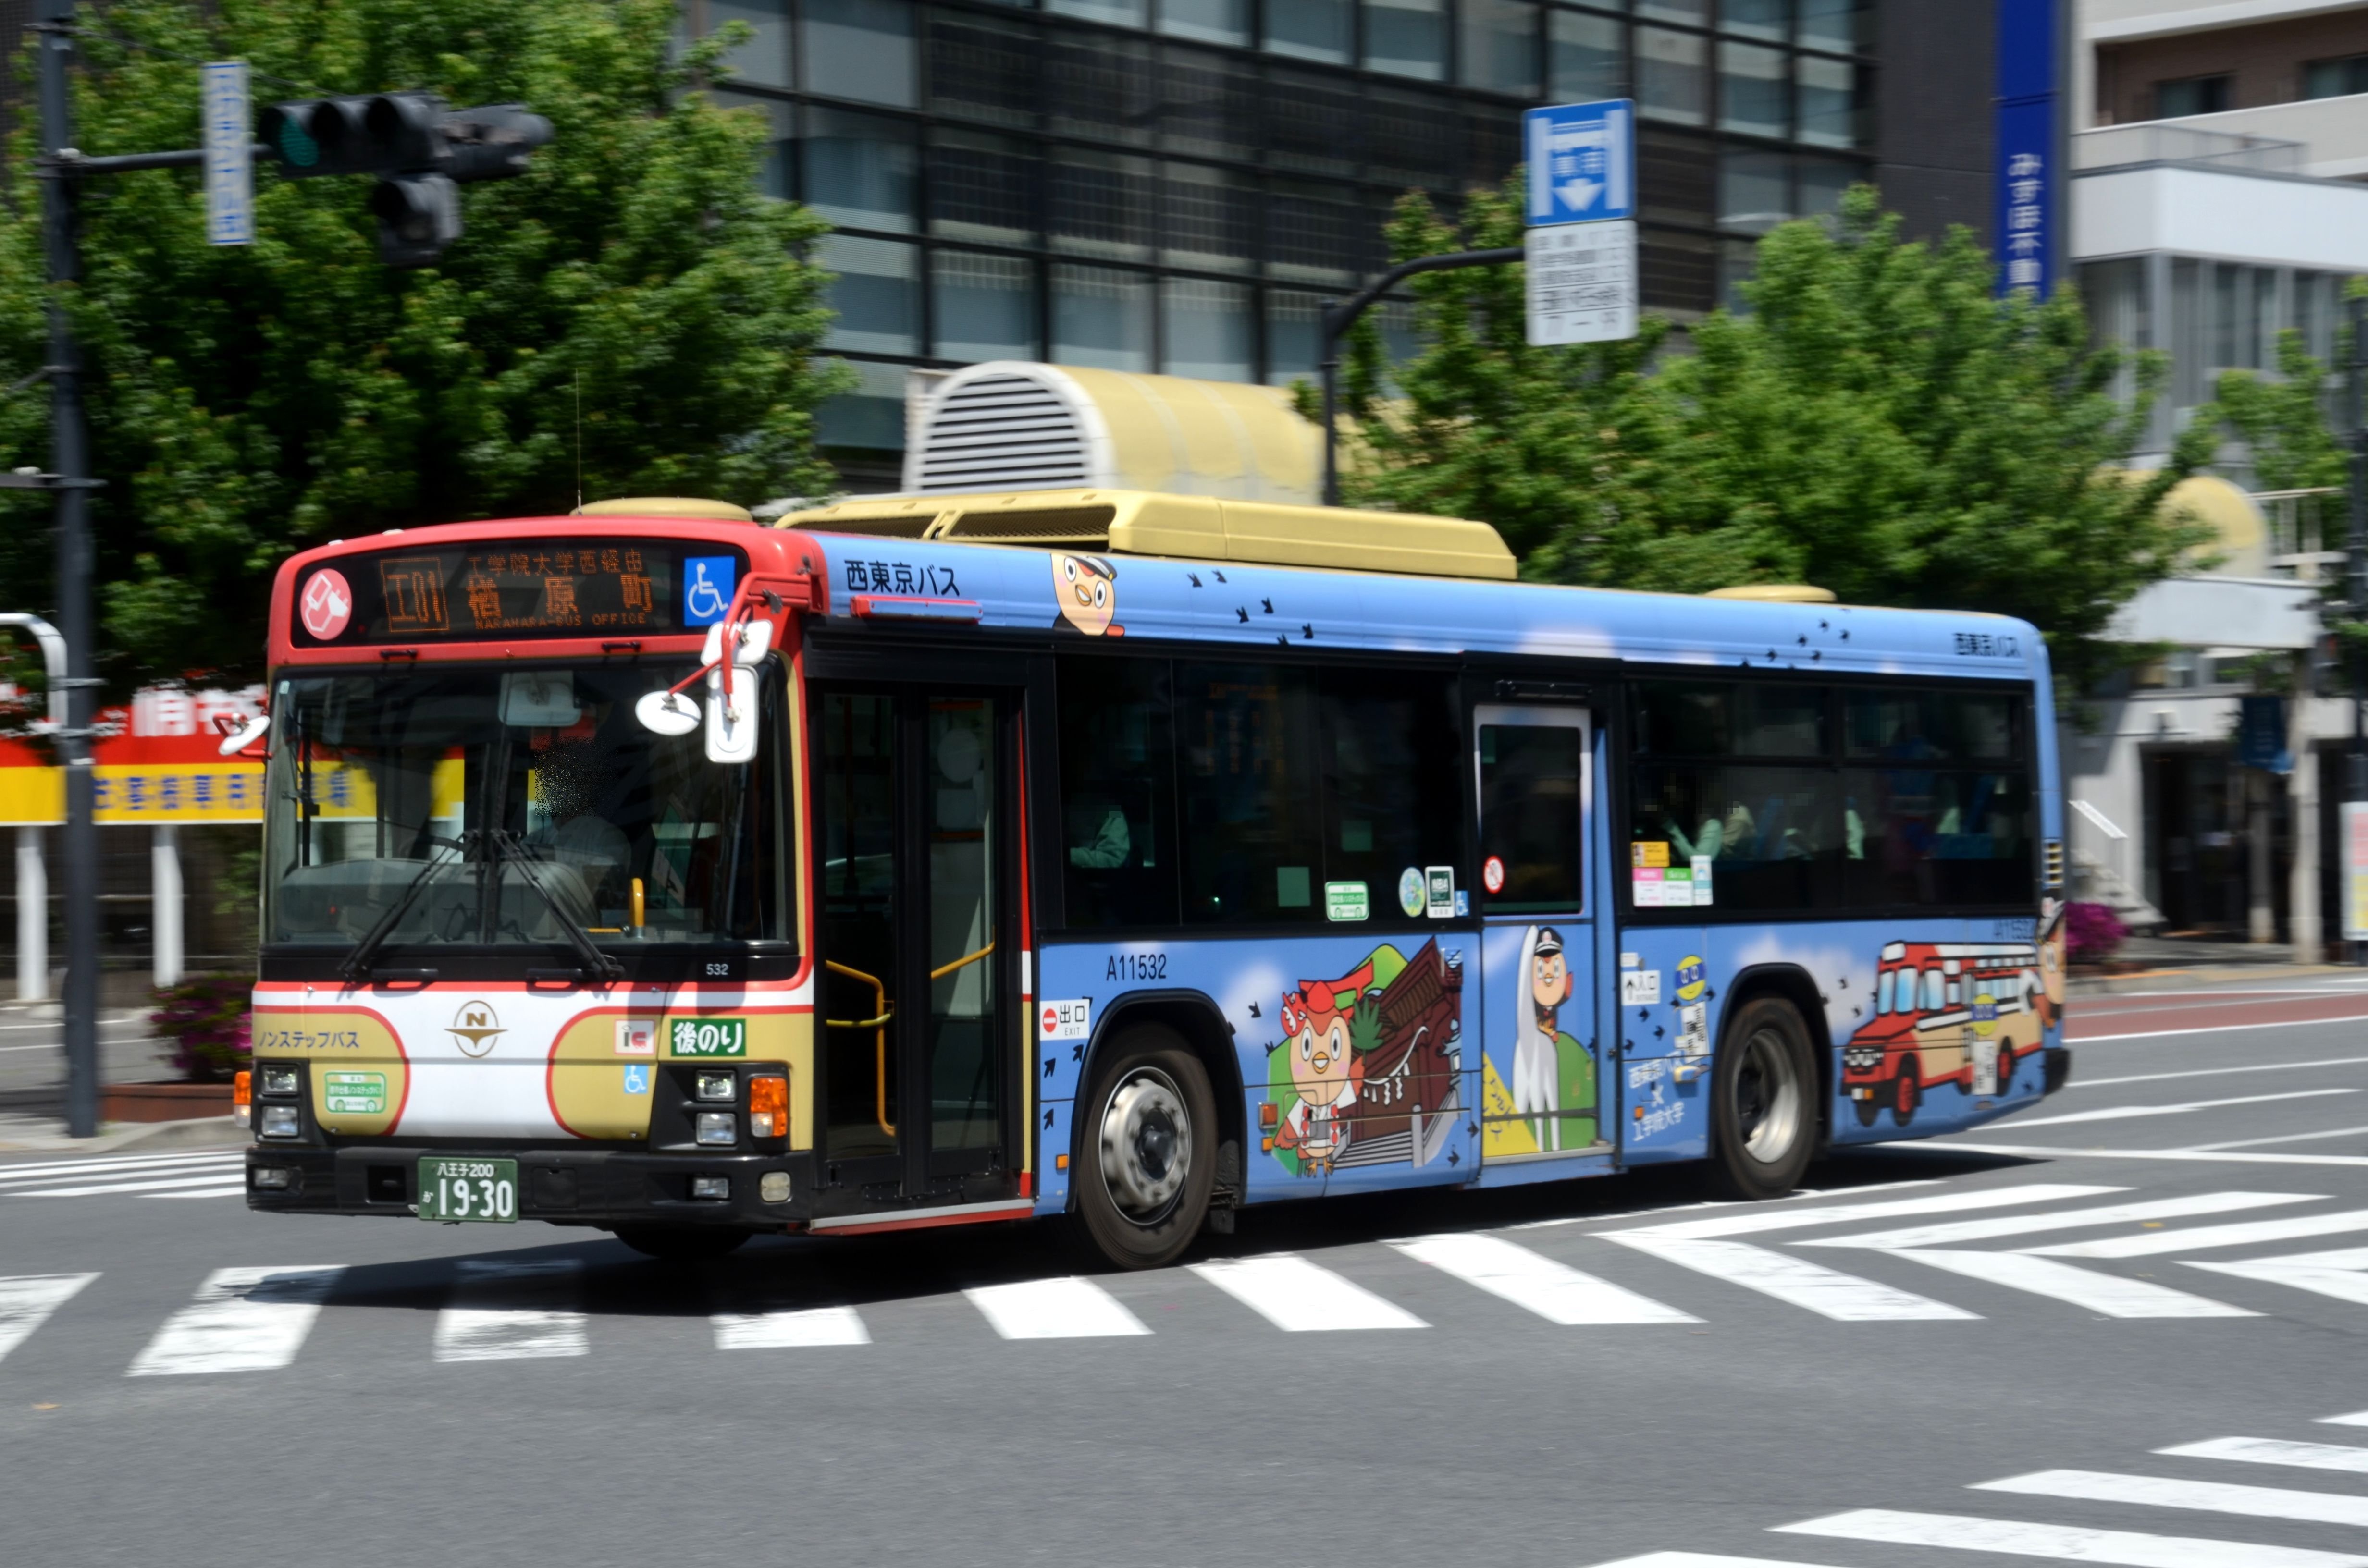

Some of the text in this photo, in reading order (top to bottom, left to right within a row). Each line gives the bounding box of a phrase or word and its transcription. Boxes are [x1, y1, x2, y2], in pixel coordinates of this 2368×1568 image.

[468, 548, 643, 576] 工学院大学西経由
[845, 560, 960, 597] 西東京バス
[592, 613, 646, 625] OFFICE
[1953, 633, 2021, 657] 西東京バス
[706, 963, 728, 976] 532
[1107, 954, 1166, 980] A11532
[1636, 975, 1657, 991] 入口
[1060, 1005, 1085, 1024] 出口
[259, 1030, 359, 1049] ノンステップバス
[673, 1020, 742, 1055] 後のり
[1065, 1027, 1080, 1036] EXIT
[1632, 1101, 1685, 1141] 工学院大学
[439, 1178, 513, 1217] 19-30
